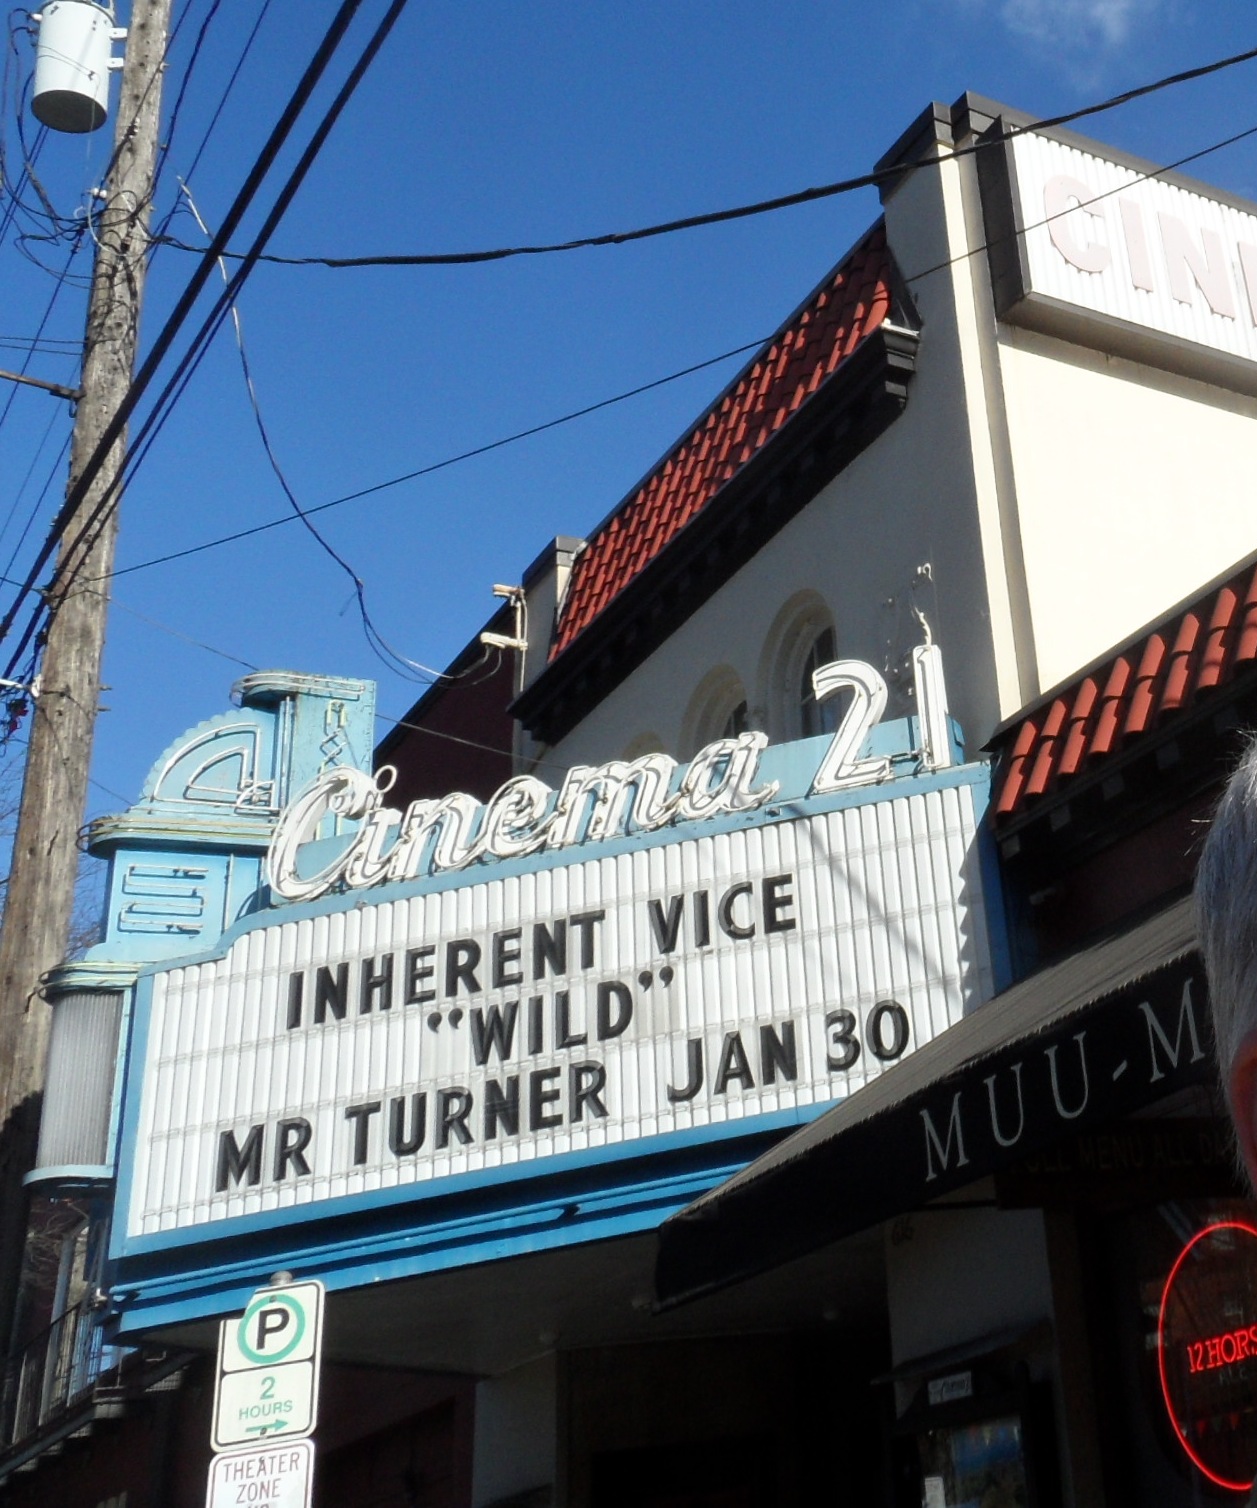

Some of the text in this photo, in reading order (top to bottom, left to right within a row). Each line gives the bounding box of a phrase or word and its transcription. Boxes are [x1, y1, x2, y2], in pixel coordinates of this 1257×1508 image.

[266, 644, 950, 900] Cinema 21
[287, 873, 797, 1031] INHERENT VICE
[215, 999, 910, 1193] MR TURNER JAN 30
[256, 1307, 290, 1351] P
[260, 1376, 276, 1400] 2
[238, 1400, 294, 1421] HOURS
[224, 1451, 300, 1483] THEATER
[235, 1478, 281, 1504] ZONE
